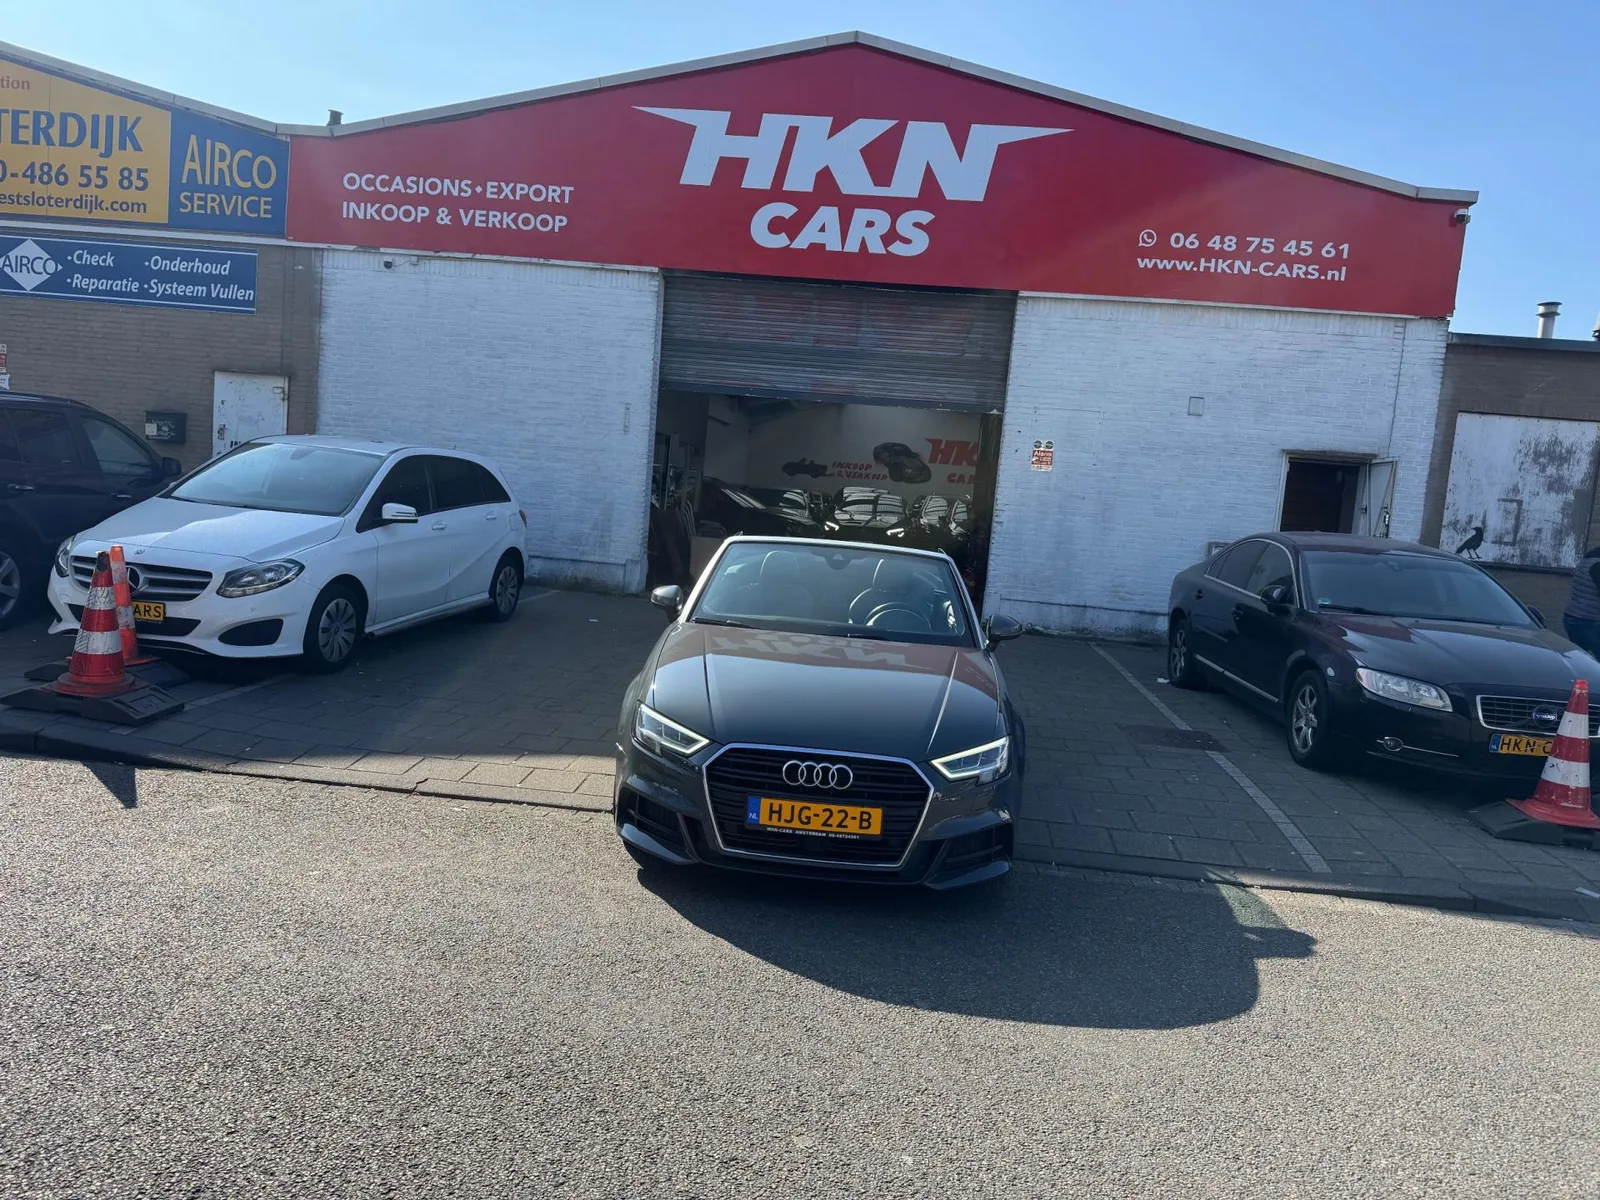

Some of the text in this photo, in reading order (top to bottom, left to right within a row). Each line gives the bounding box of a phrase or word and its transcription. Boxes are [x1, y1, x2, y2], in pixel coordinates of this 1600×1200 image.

[181, 133, 277, 190] AIRCO
[631, 105, 1076, 202] HKN
[78, 164, 109, 190] 55
[117, 166, 149, 191] 85
[342, 172, 574, 204] OCCASIONS EXPORT
[179, 191, 273, 219] SERVICE
[342, 201, 568, 233] INKOOP & VERKOOP
[749, 202, 936, 256] CARS
[72, 249, 115, 267] Check
[1169, 232, 1350, 259] 06 48 75 45 61
[2, 254, 58, 276] AIRCO
[150, 255, 231, 276] Onderhoud
[1136, 257, 1347, 282] www.HKN-CARS.nl
[72, 274, 140, 294] Reparatie
[149, 278, 255, 301] Systeem Vullen
[748, 802, 872, 830] NL HJG-22-B
